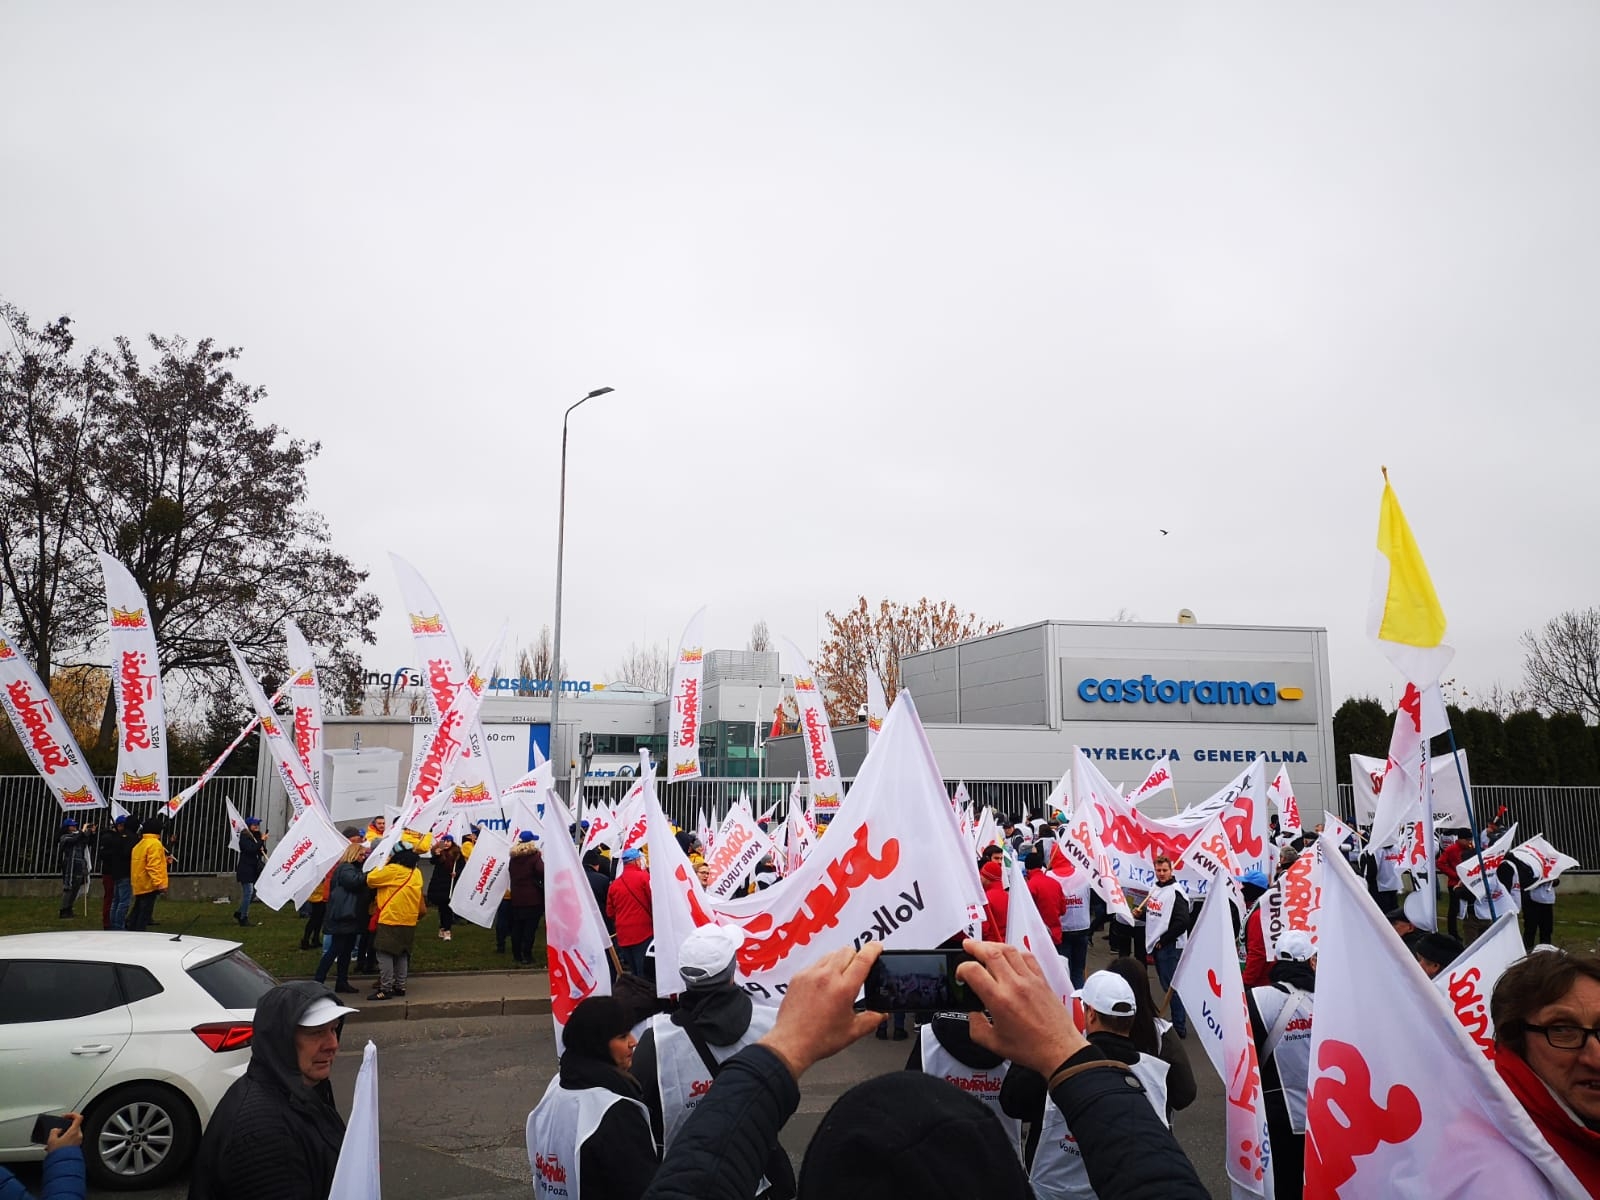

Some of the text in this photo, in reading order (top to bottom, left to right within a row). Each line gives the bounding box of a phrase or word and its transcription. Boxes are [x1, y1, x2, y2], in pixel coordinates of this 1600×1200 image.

[1078, 674, 1277, 706] castorama
[487, 733, 499, 742] 60
[1081, 748, 1308, 764] DYREKCJA GENERALNA
[1065, 840, 1090, 870] KWB
